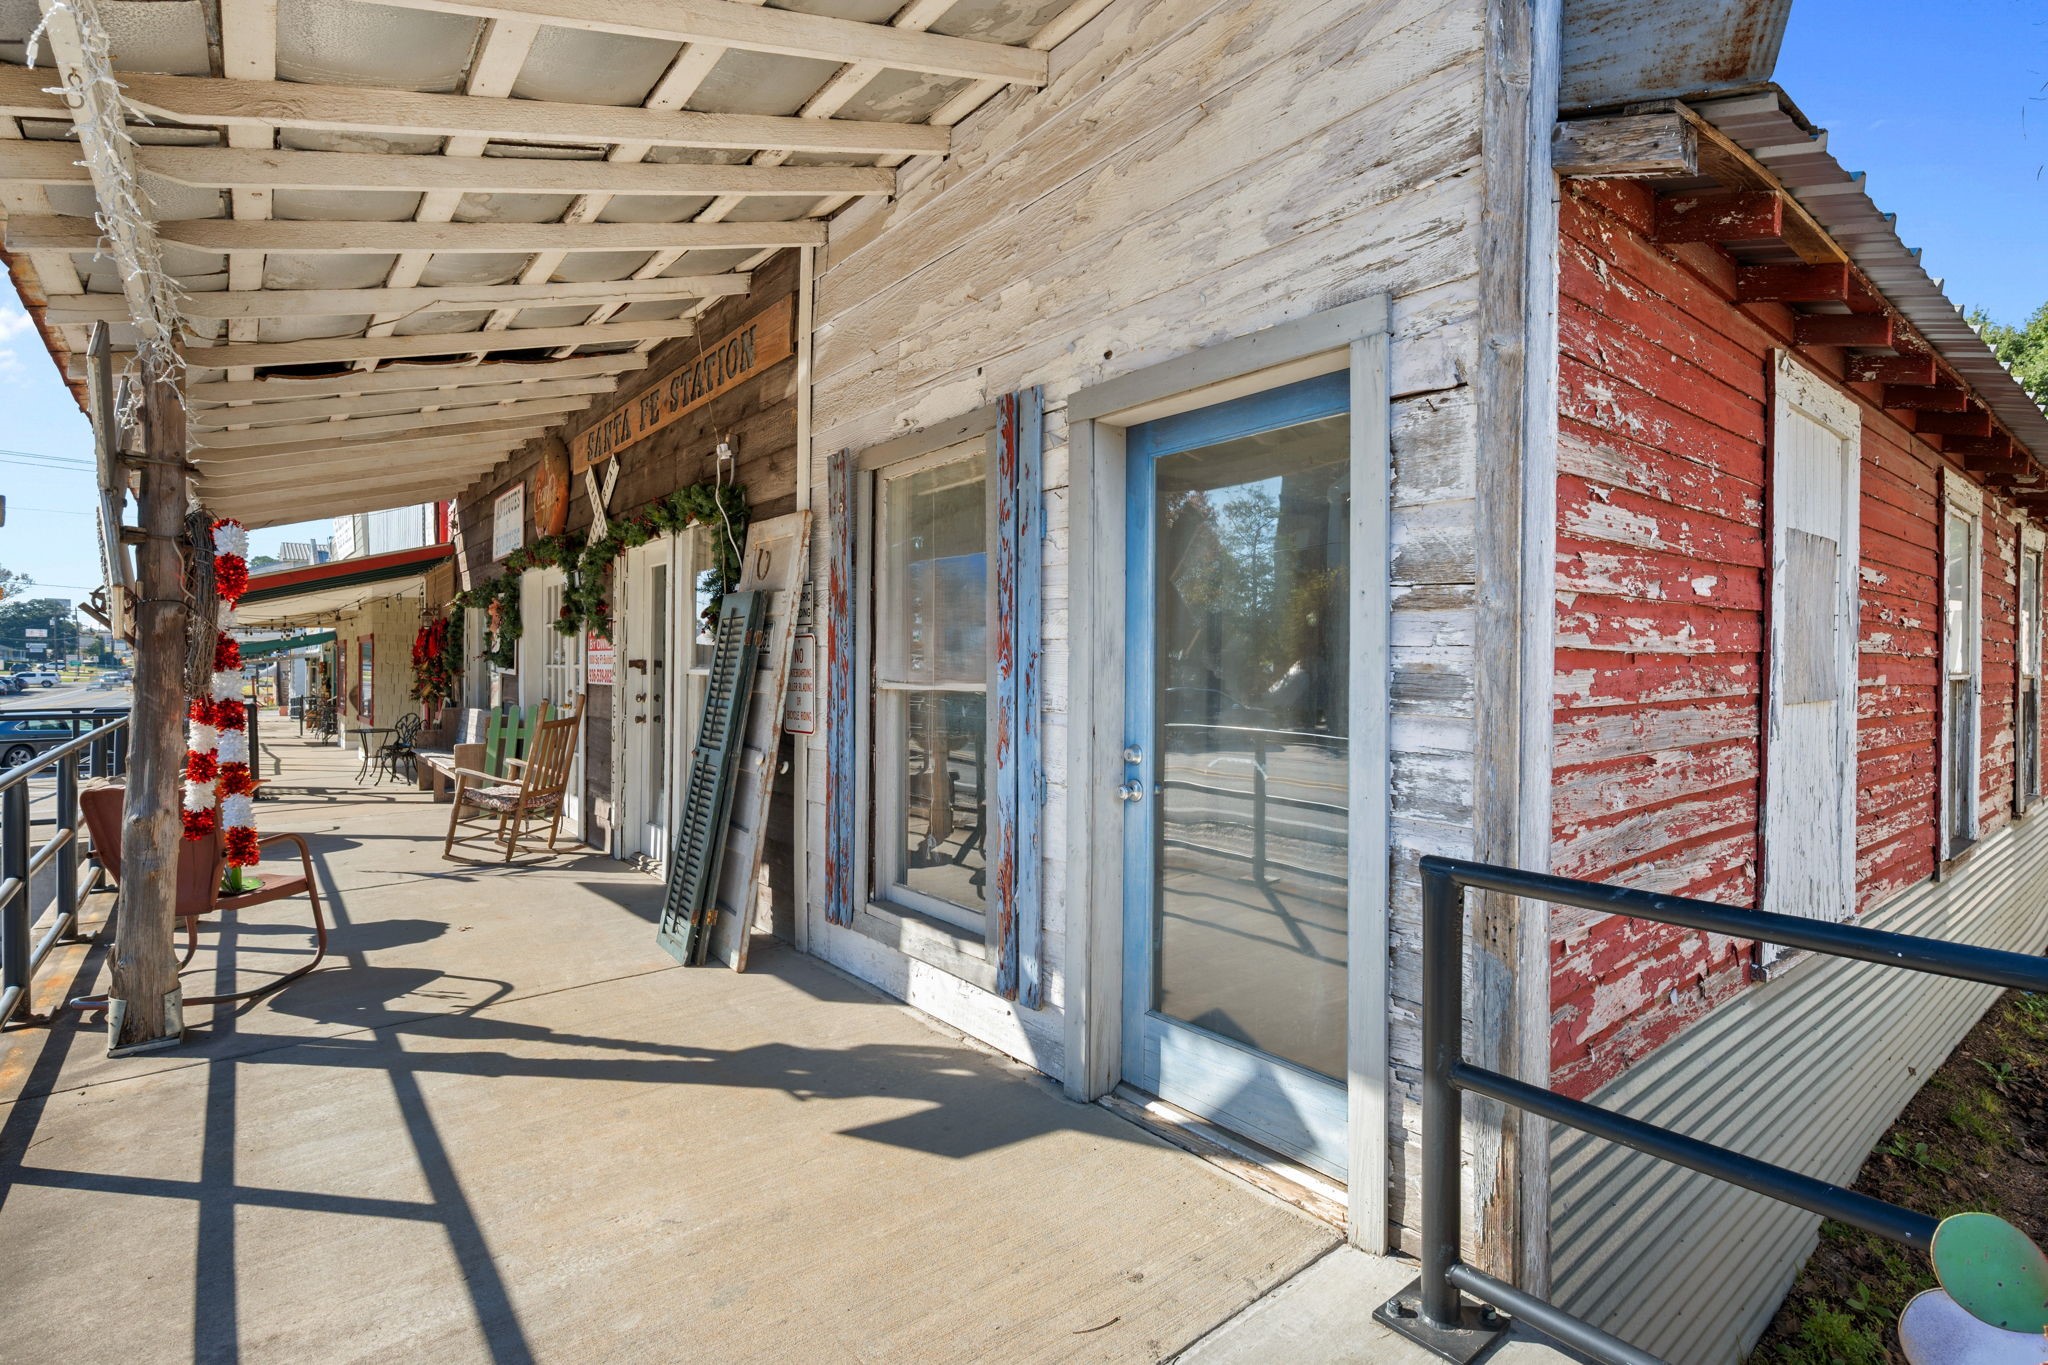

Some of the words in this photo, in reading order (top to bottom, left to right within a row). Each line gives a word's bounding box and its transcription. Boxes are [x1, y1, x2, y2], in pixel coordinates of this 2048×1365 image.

[587, 408, 632, 462] SANTA
[639, 388, 661, 432] FE
[669, 324, 757, 413] STATION
[602, 459, 616, 500] ROAD
[588, 477, 606, 536] CROSSIN
[794, 648, 804, 663] NO
[787, 682, 798, 692] OLLER
[790, 668, 813, 678] ATEBOARDING
